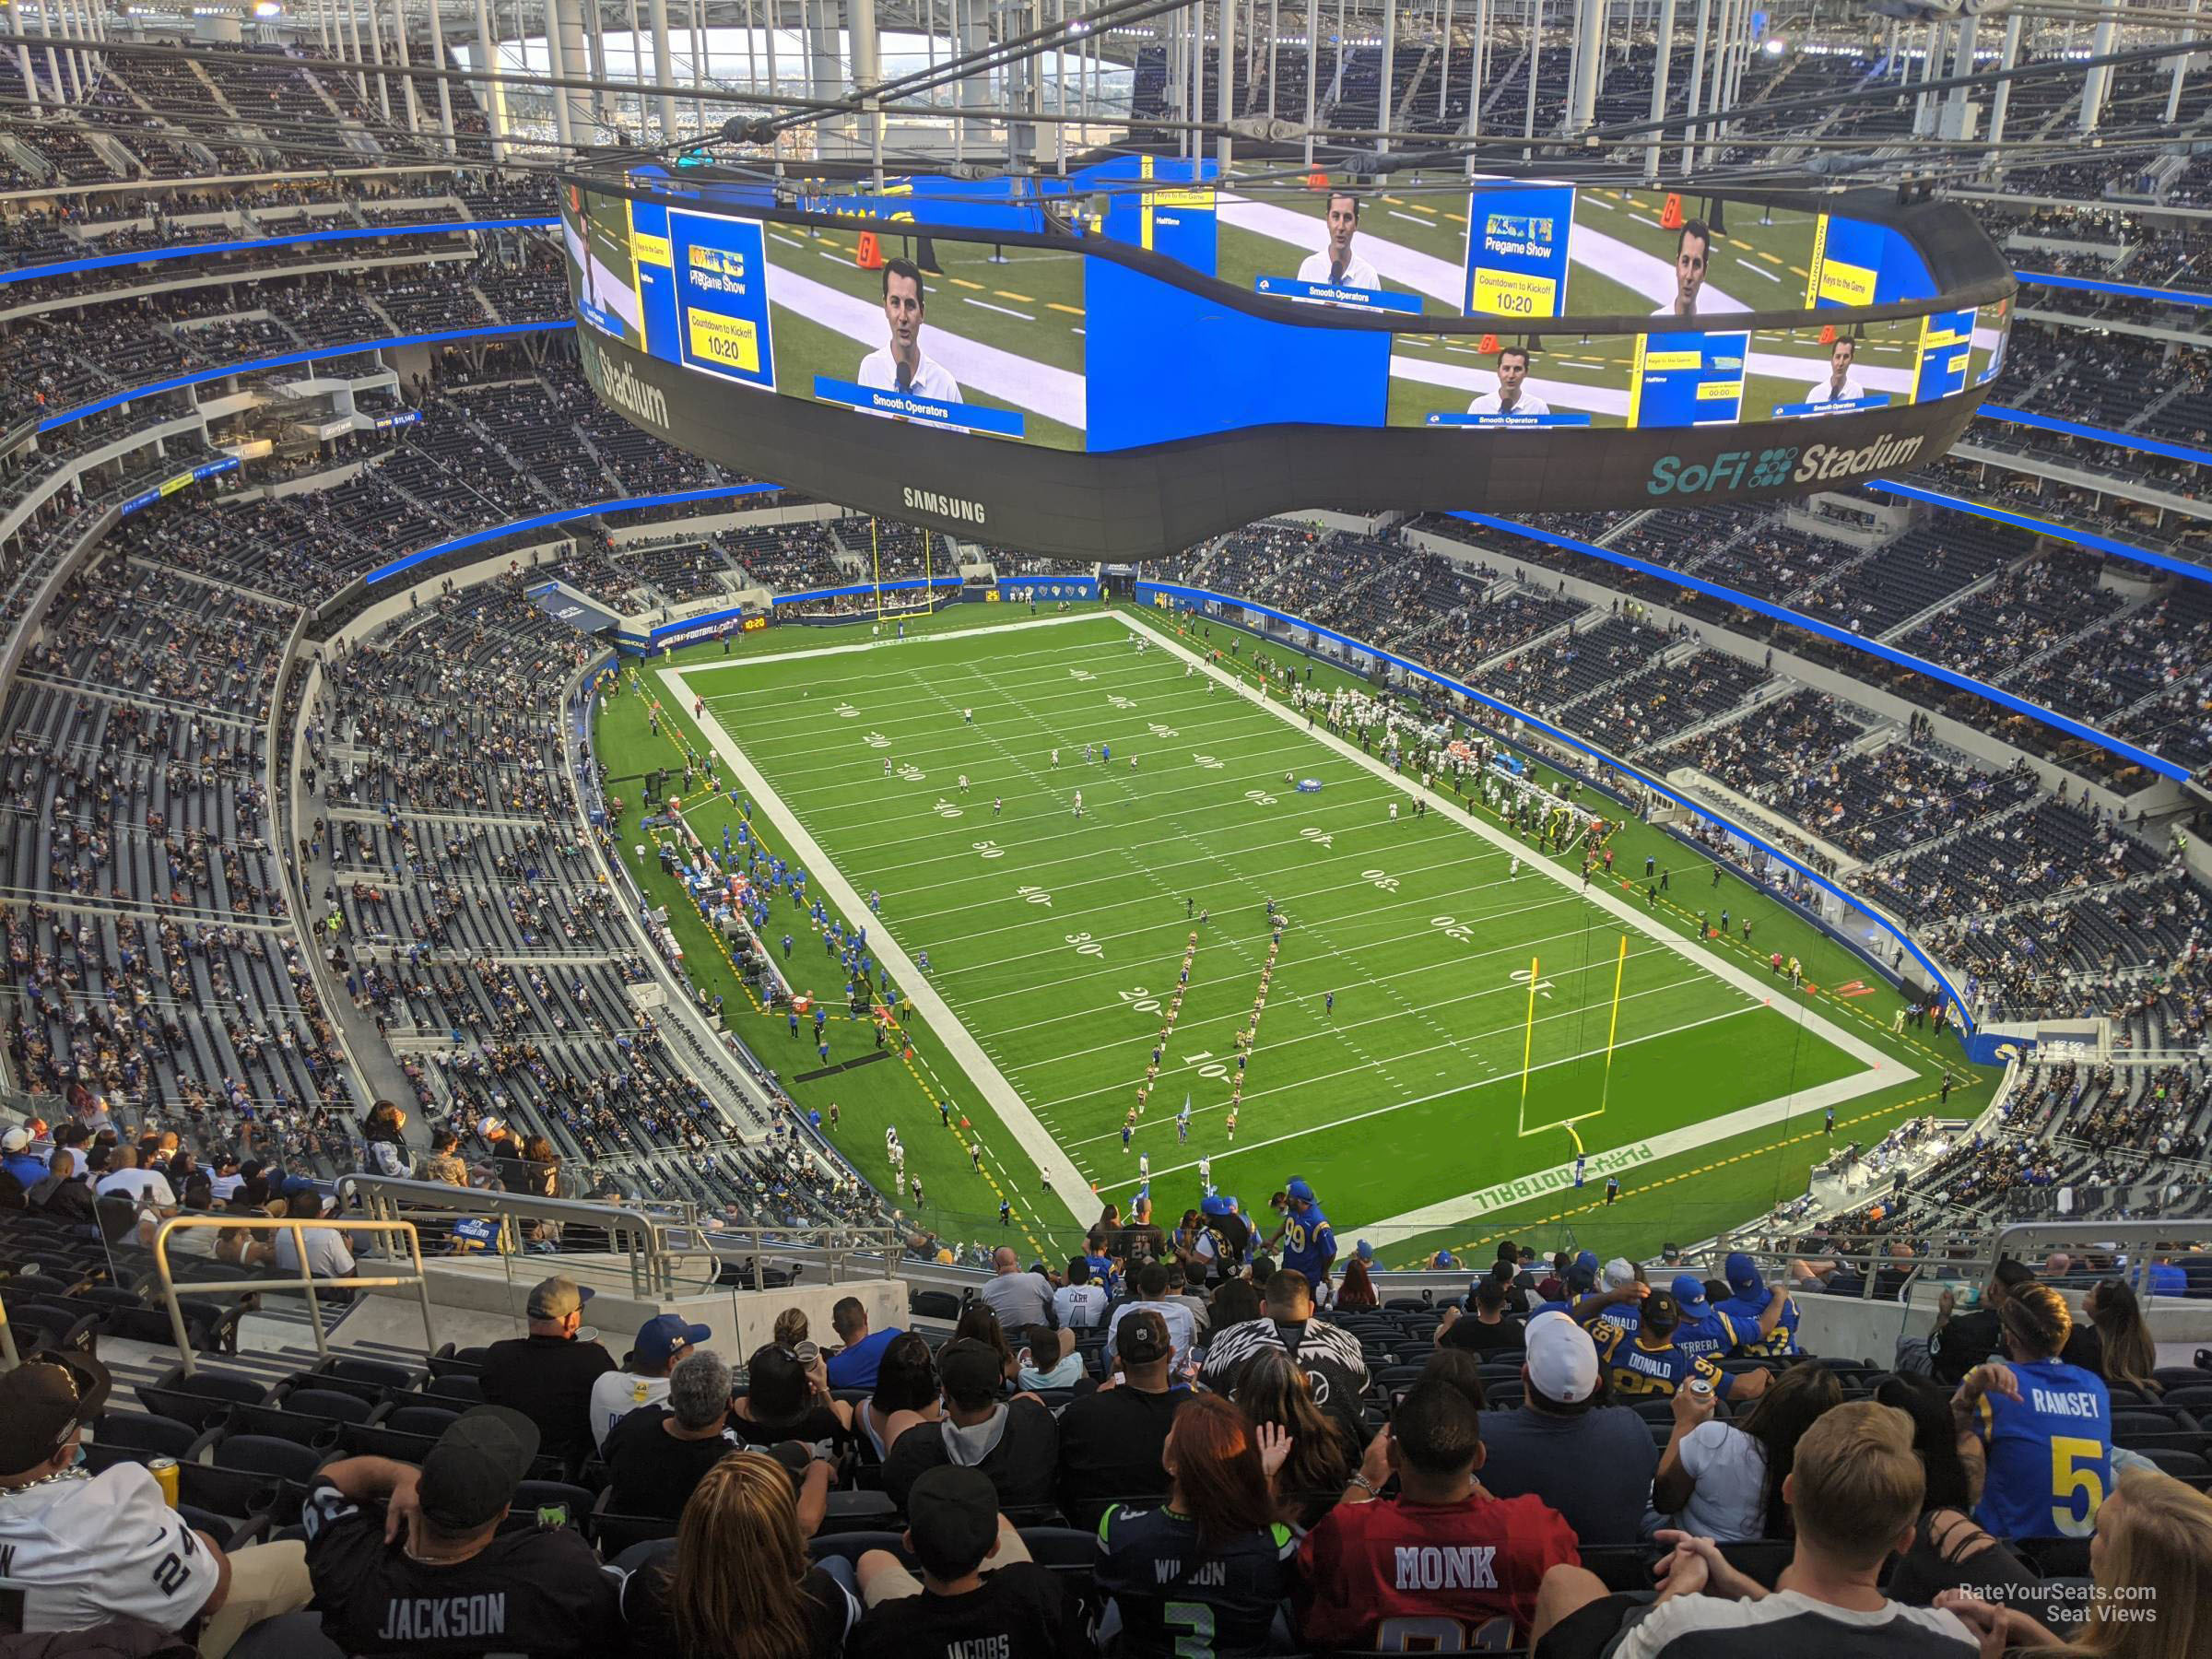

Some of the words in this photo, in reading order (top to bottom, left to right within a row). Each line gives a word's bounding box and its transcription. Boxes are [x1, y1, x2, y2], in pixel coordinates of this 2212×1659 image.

[860, 237, 871, 262] G
[1485, 237, 1524, 254] Pregame
[1526, 241, 1552, 258] Show
[690, 269, 723, 291] Pregame
[723, 274, 746, 295] Show
[1479, 275, 1517, 288] Countdown
[1519, 281, 1526, 290] to
[1527, 281, 1551, 295] Kickoff
[1823, 273, 1836, 288] Keys
[1837, 278, 1842, 287] to
[1842, 279, 1851, 289] the
[1852, 281, 1865, 294] Game
[1310, 286, 1335, 298] Smooth
[1335, 289, 1369, 302] Operators
[1497, 292, 1532, 313] 10:20
[692, 315, 724, 333] Countdown
[724, 324, 730, 334] to
[731, 325, 752, 339] Kickoff
[709, 335, 739, 359] 10:20
[599, 347, 670, 429] Stadium
[873, 394, 904, 410] Smooth
[905, 400, 948, 418] Operators
[1505, 417, 1538, 425] Operators
[1647, 451, 1751, 495] SoFi
[1794, 434, 1924, 482] Stadium
[903, 487, 985, 524] SAMSUNG
[745, 618, 764, 629] 10:20
[1070, 669, 1098, 681] 10
[833, 704, 861, 718] 10
[1108, 696, 1137, 709] 20
[863, 734, 891, 747] 20
[1149, 724, 1180, 738] 30
[897, 766, 926, 781] 30
[1194, 756, 1225, 769] 40
[1244, 790, 1278, 806] 50
[933, 803, 963, 818] 40
[1300, 828, 1335, 843] 40
[972, 840, 1005, 858] 50
[1361, 869, 1400, 889] 30
[1017, 886, 1051, 903] 40
[1430, 916, 1475, 938] 20
[1065, 932, 1102, 954] 30
[1509, 970, 1556, 993] 10
[1118, 987, 1160, 1012] 20
[1182, 1051, 1228, 1077] 10
[1472, 1168, 1574, 1209] OOTBALL
[1285, 1217, 1306, 1253] 99
[1069, 1294, 1088, 1303] CARR
[1068, 1305, 1087, 1327] 4
[1601, 1313, 1638, 1331] DONALD
[1628, 1352, 1671, 1378] DONALD
[2031, 1388, 2100, 1418] RAMSEY
[2050, 1435, 2104, 1537] 5
[1155, 1559, 1226, 1586] WION
[1394, 1547, 1499, 1590] MONK
[378, 1592, 505, 1640] JACKSON
[1164, 1601, 1216, 1659] 3
